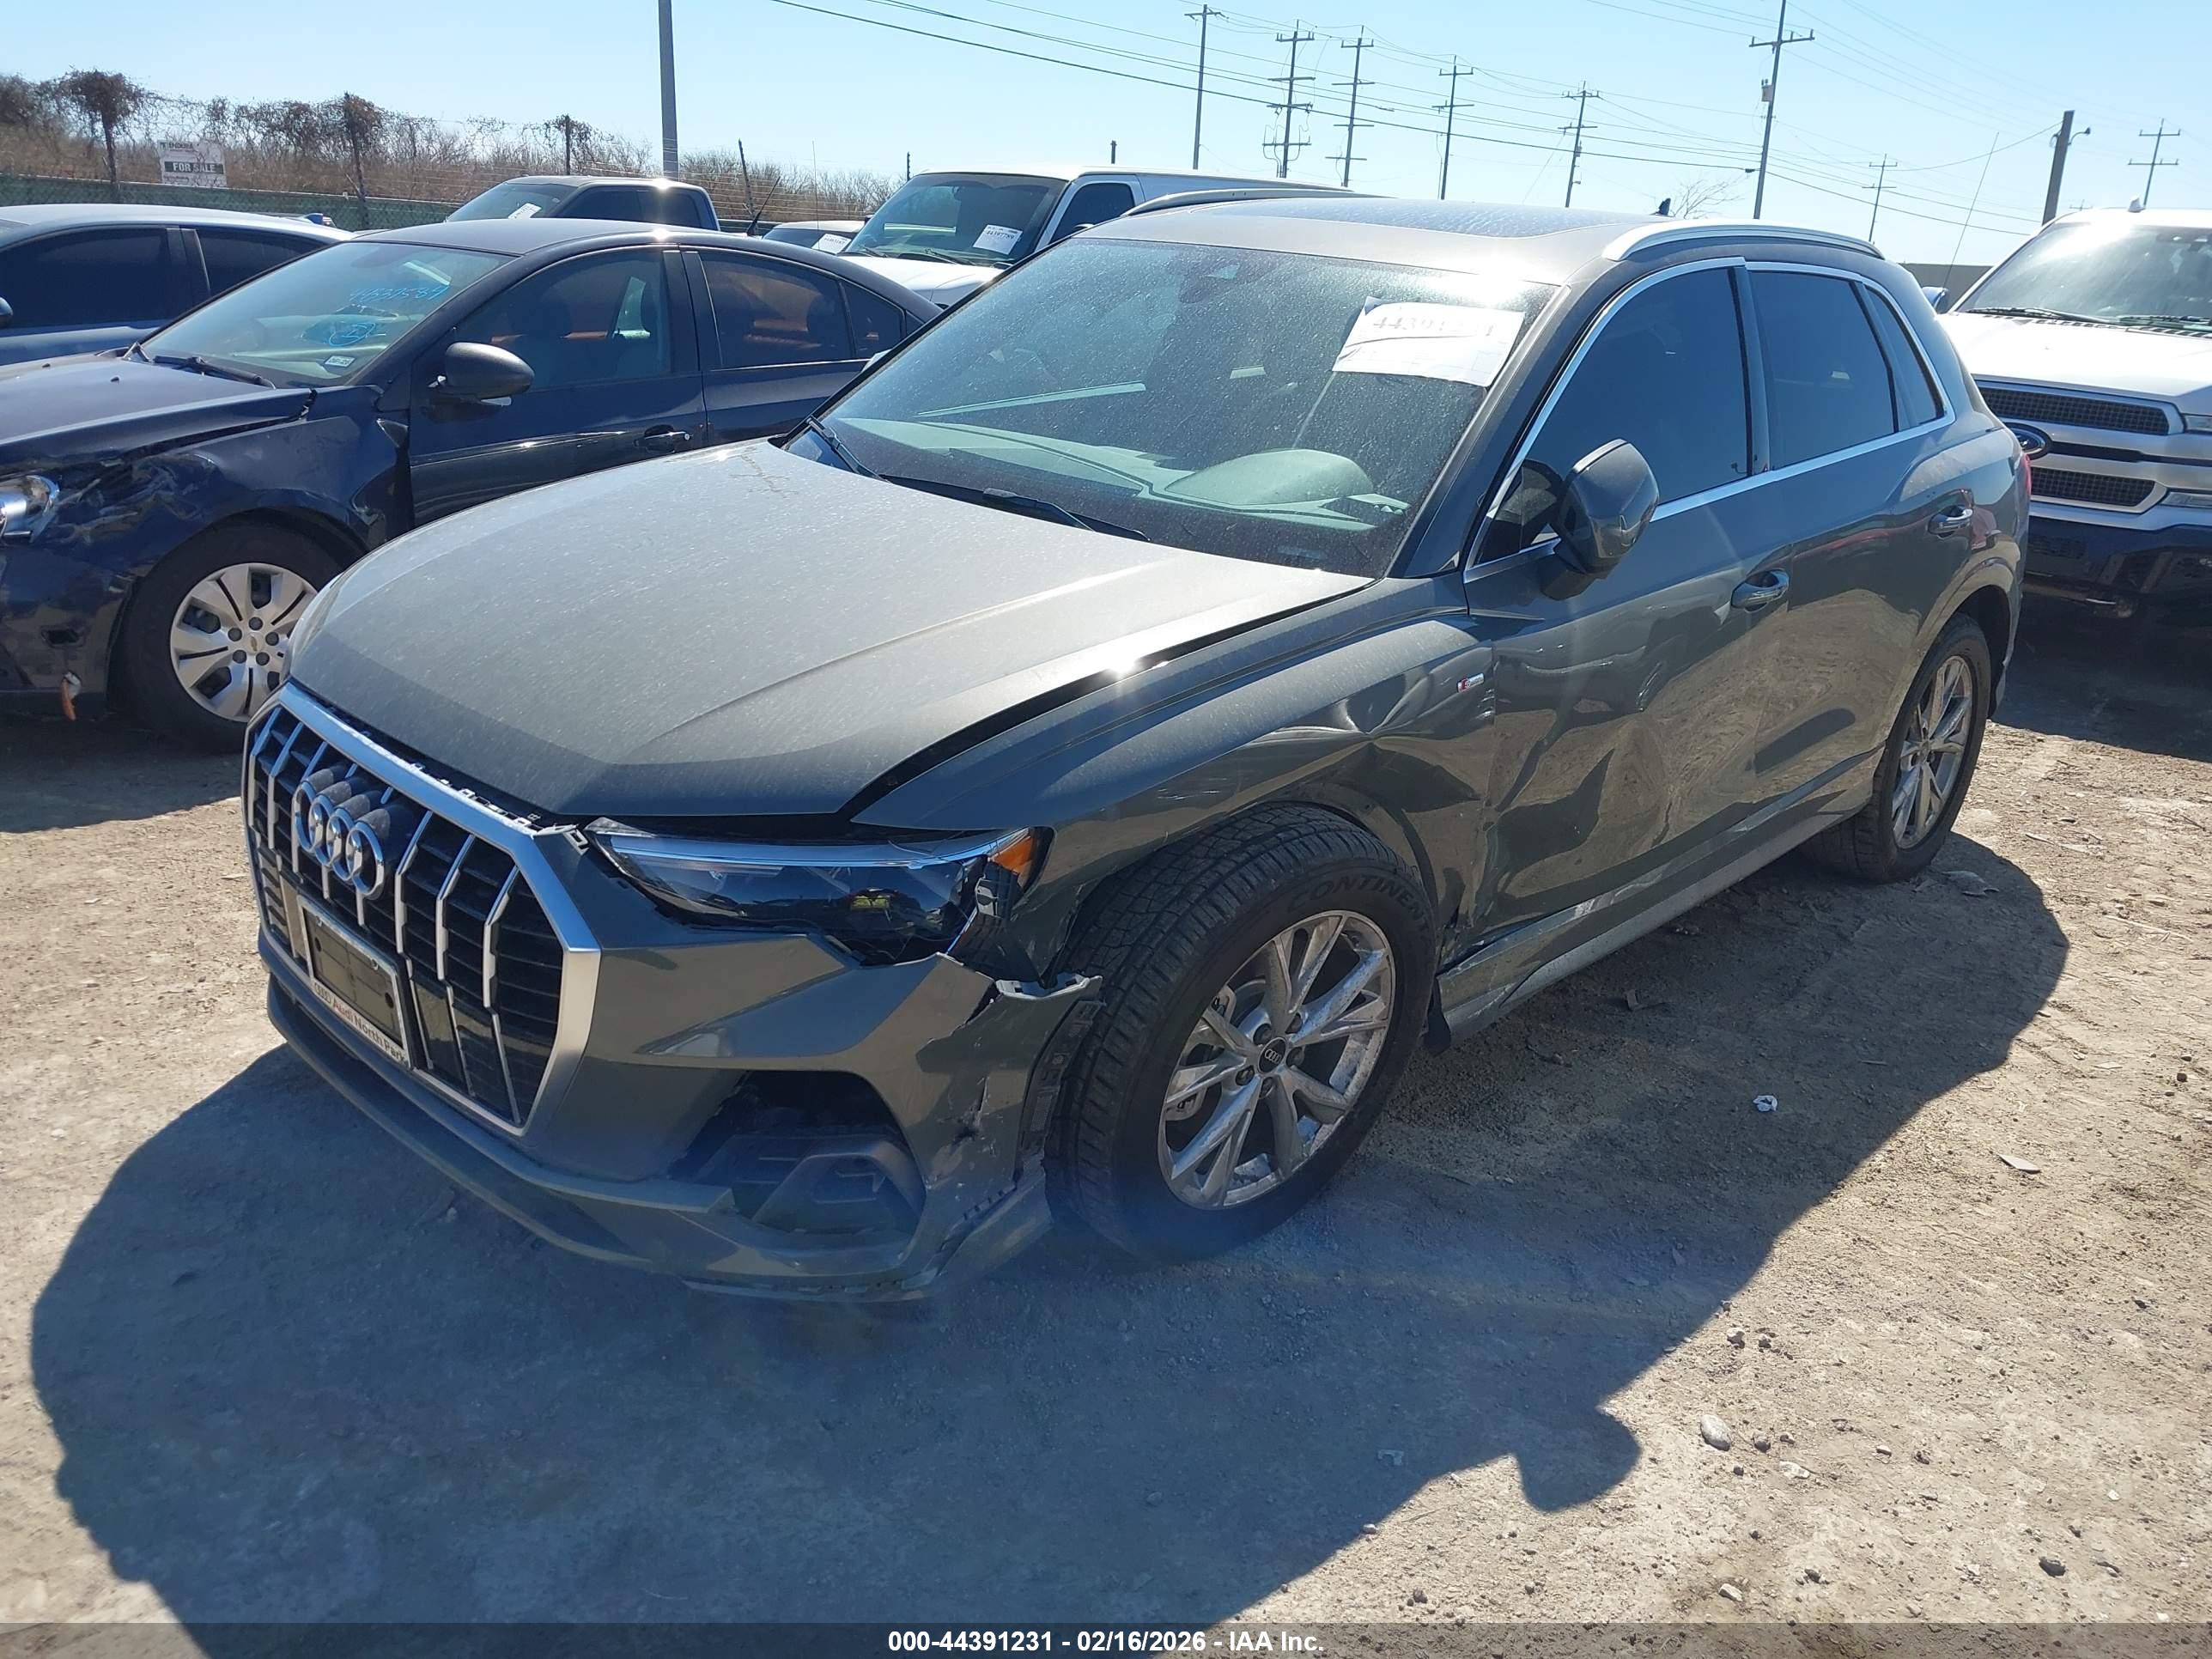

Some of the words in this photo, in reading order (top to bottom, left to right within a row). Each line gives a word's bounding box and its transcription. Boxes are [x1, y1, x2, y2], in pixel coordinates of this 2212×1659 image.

[173, 162, 191, 172] FOR
[192, 163, 216, 173] SALE
[332, 997, 354, 1022] Audi
[354, 1016, 384, 1047] North
[383, 1039, 405, 1061] Park
